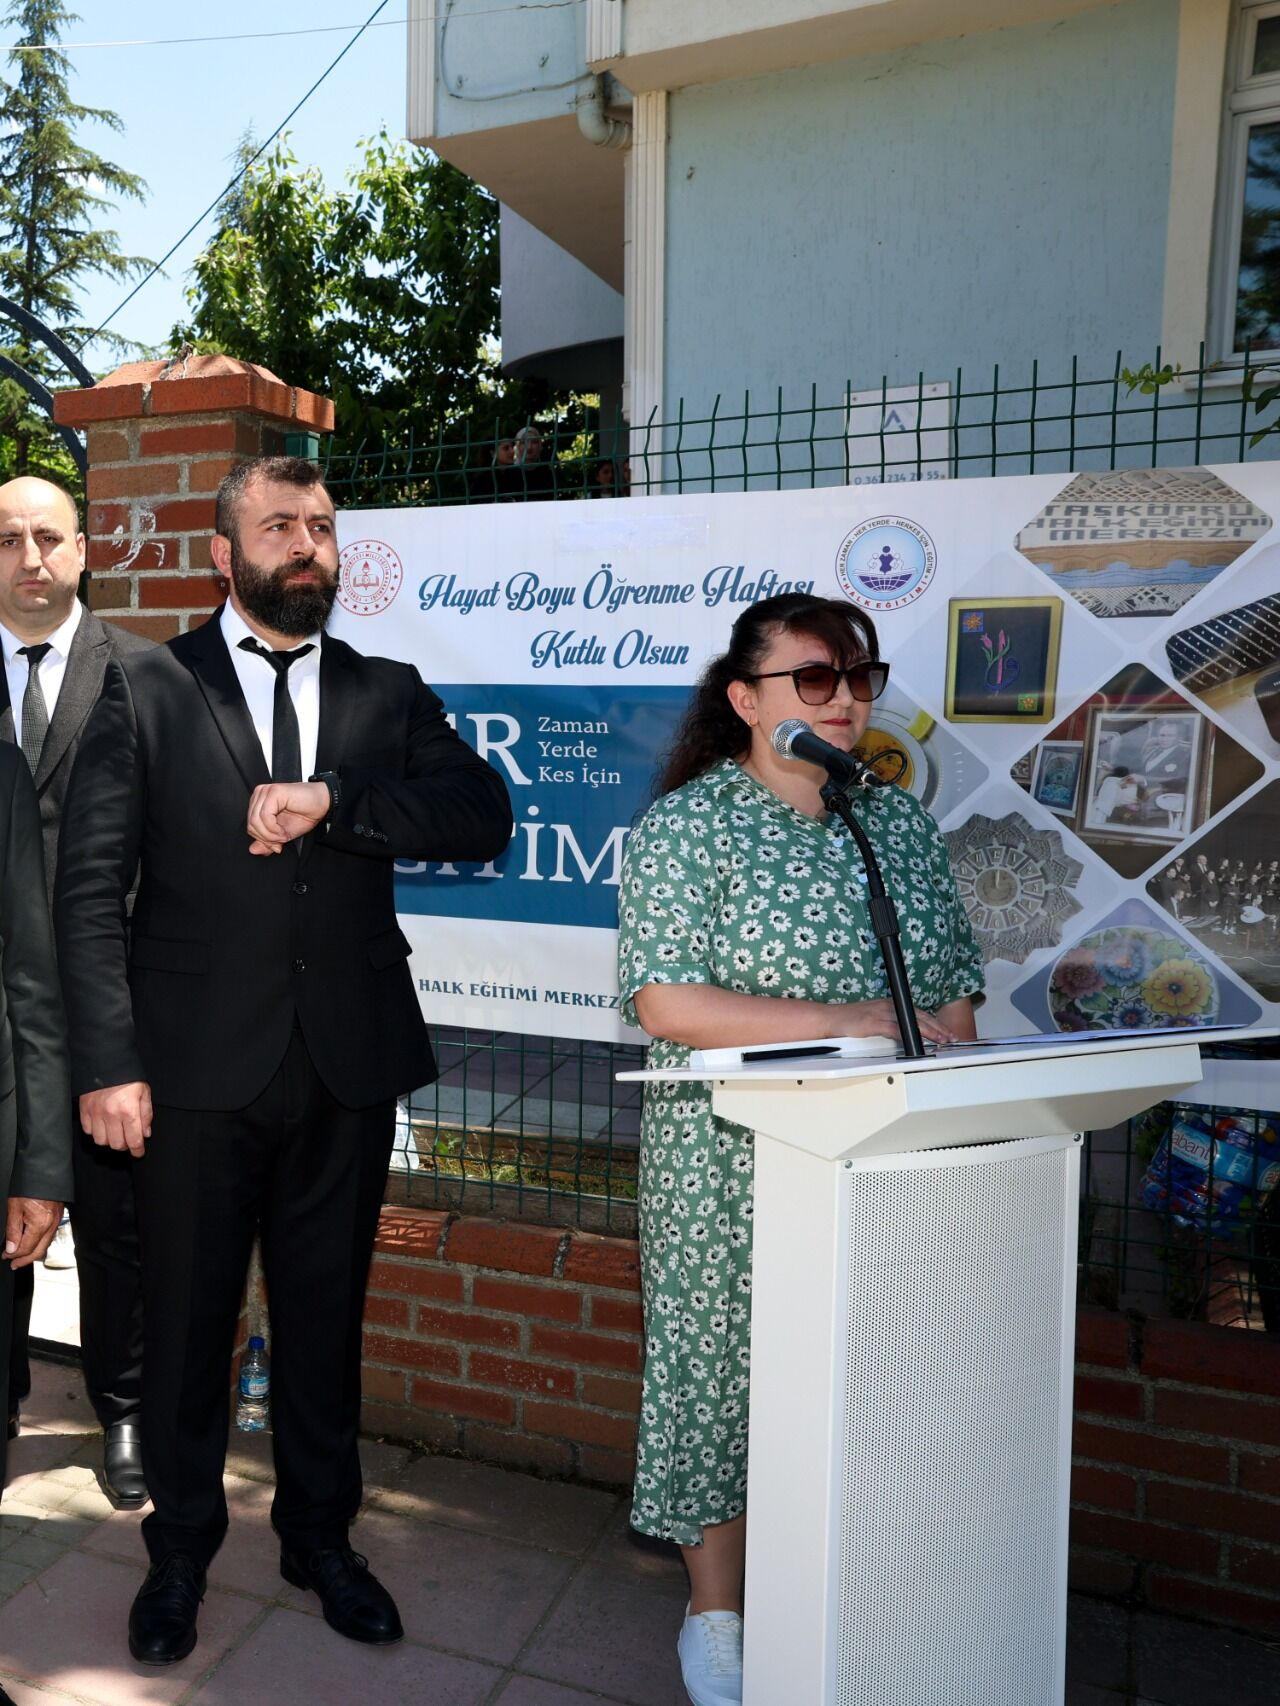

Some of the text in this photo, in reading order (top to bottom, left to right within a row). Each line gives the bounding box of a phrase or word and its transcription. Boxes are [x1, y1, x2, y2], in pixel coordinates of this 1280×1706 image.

[868, 519, 891, 529] YERDE
[895, 519, 922, 536] HERKES
[418, 574, 501, 616] Hayat
[505, 571, 577, 615] Boyu
[583, 563, 696, 614] Öğrenme
[843, 583, 871, 607] HALK
[530, 629, 690, 669] Kutlu Olsun
[537, 716, 609, 734] Zaman
[537, 740, 598, 758] Yerde
[538, 763, 622, 788] Kes İçin
[418, 978, 465, 995] HALK
[469, 980, 538, 1002] EĞİTİMİ
